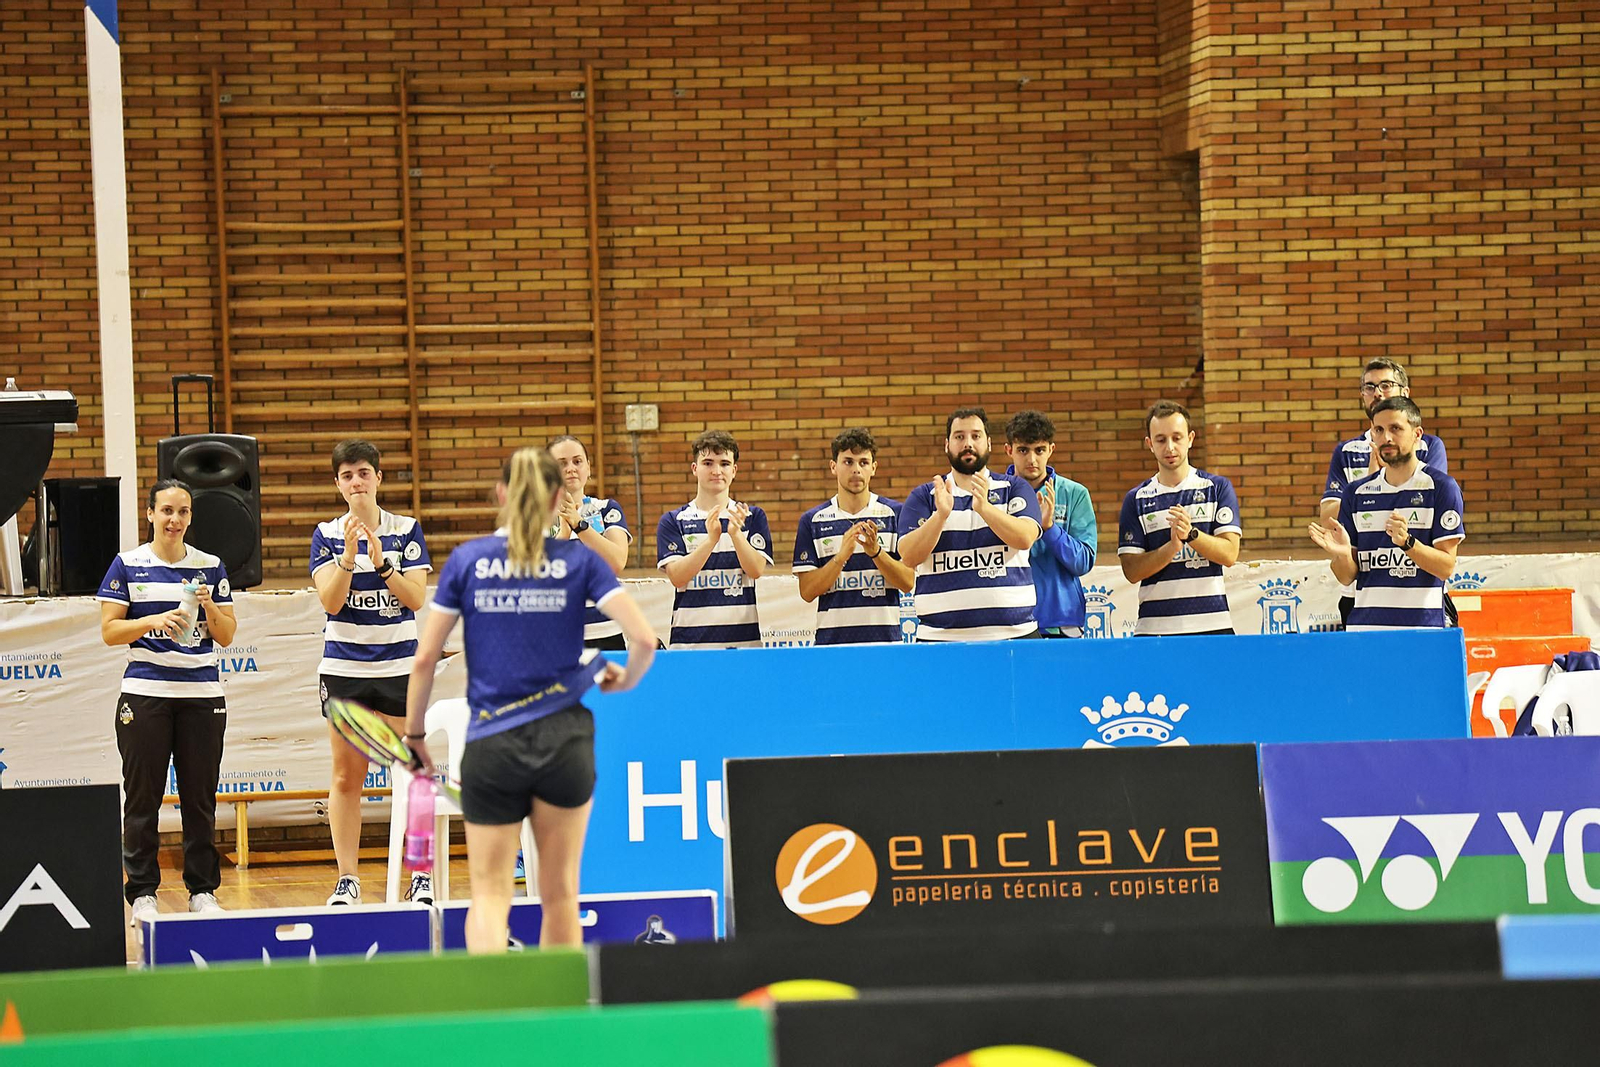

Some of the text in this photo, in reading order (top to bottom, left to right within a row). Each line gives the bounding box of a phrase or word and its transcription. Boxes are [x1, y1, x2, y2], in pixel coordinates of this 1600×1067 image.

[932, 549, 1005, 573] Huelva
[834, 571, 886, 590] uelva
[50, 651, 62, 660] de
[246, 645, 258, 653] de
[0, 664, 62, 680] UELVA
[217, 657, 258, 673] LVA
[79, 776, 91, 785] de
[220, 768, 287, 779] untamiento de
[888, 820, 1219, 871] enclave
[892, 881, 993, 907] papelería
[1003, 879, 1083, 899] técnica
[1109, 874, 1219, 900] copistería
